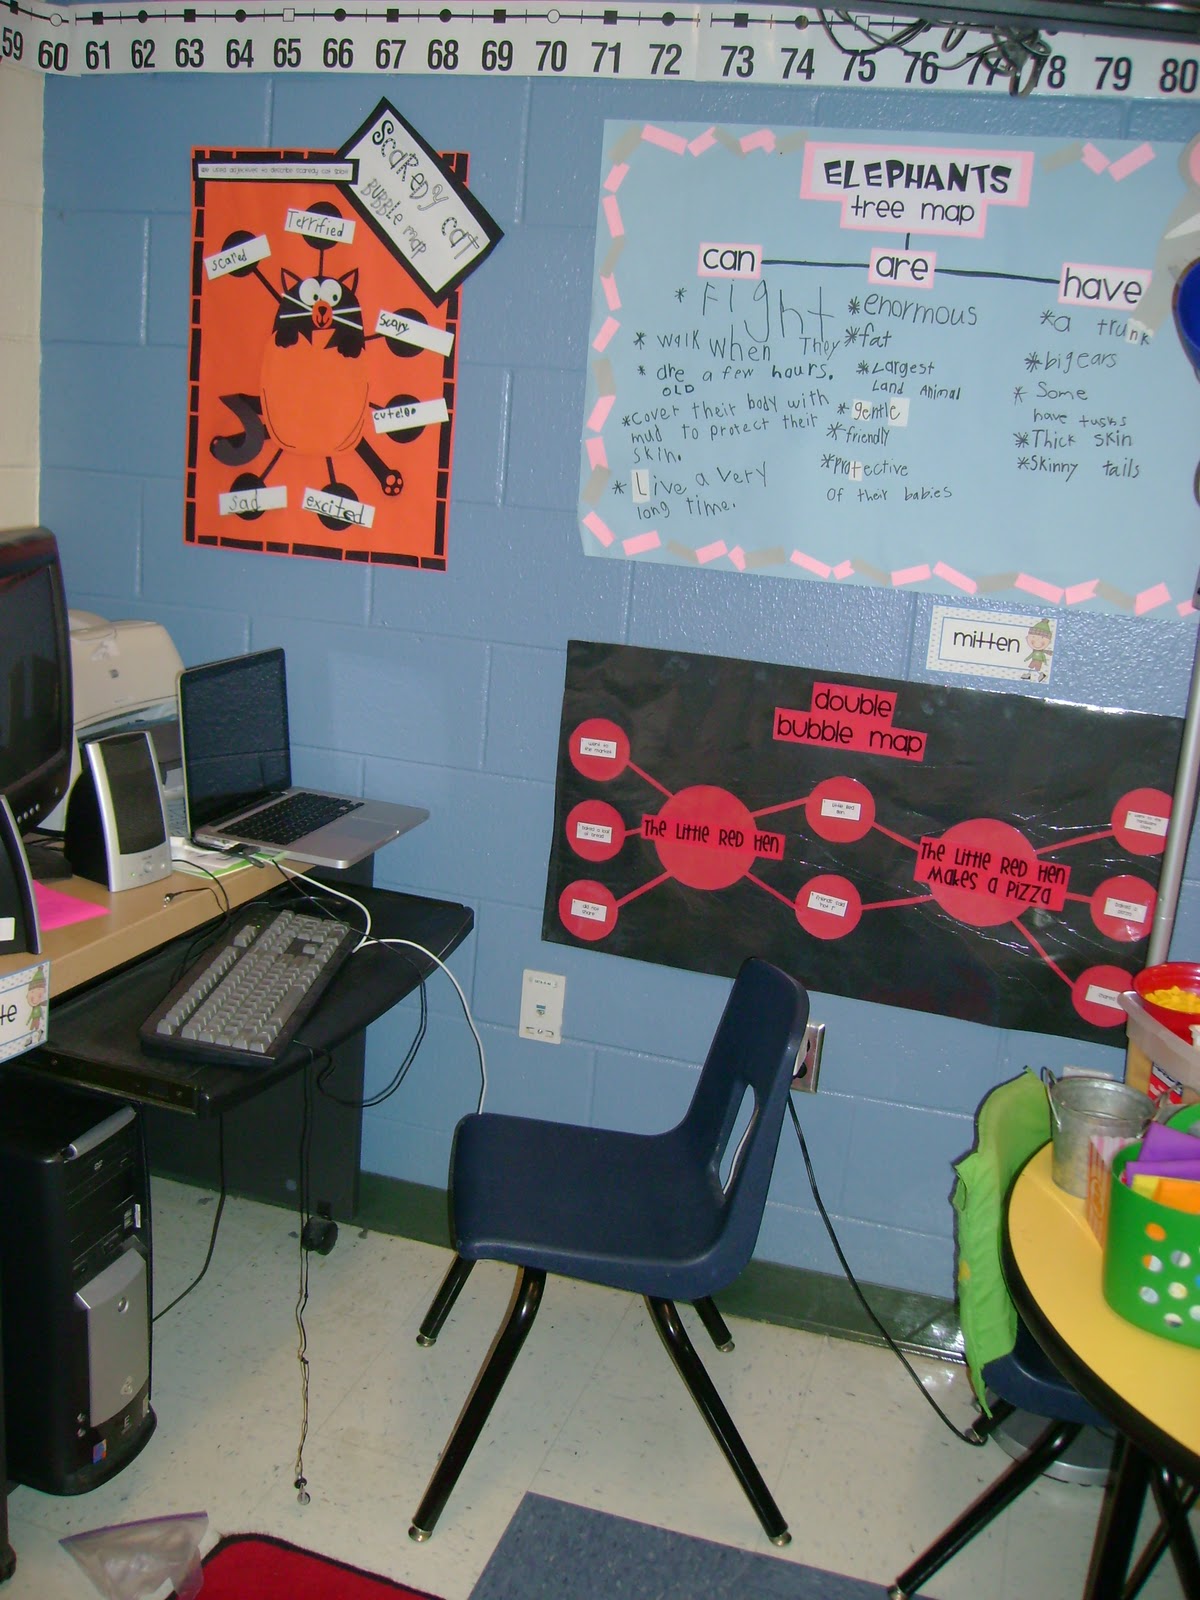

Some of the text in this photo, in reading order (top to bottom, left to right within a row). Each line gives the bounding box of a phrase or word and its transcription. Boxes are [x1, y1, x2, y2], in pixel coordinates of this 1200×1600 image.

[2, 27, 24, 61] 59
[37, 40, 69, 72] 60
[85, 40, 111, 69] 61
[130, 39, 156, 69] 62
[174, 39, 205, 68] 63
[225, 39, 254, 68] 64
[273, 38, 302, 68] 65
[323, 38, 354, 68] 66
[375, 39, 407, 69] 67
[427, 39, 459, 70] 68
[481, 40, 514, 71] 69
[536, 40, 568, 72] 70
[592, 42, 622, 74] 71
[648, 43, 682, 76] 72
[720, 44, 755, 78] 73
[780, 47, 815, 80] 74
[842, 49, 877, 83] 75
[903, 51, 939, 85] 76
[1094, 56, 1132, 91] 79
[1159, 58, 1197, 94] 80
[823, 159, 1013, 195] ELEPHANTS
[287, 209, 346, 237] Terrified
[850, 194, 975, 226] tree map
[702, 246, 755, 272] can
[875, 254, 929, 283] are
[1063, 269, 1143, 304] have
[702, 278, 836, 344] Fight
[863, 293, 978, 326] enormous
[858, 322, 893, 348] fat
[1053, 315, 1072, 332] a
[702, 370, 713, 382] a
[722, 364, 755, 381] few
[771, 363, 834, 382] hours.
[871, 360, 936, 378] Largest
[661, 384, 695, 397] OLD
[872, 379, 905, 396] Land
[692, 401, 737, 420] their
[746, 393, 779, 413] body
[787, 388, 830, 409] with
[1033, 408, 1068, 424] have
[631, 424, 663, 444] mud
[709, 417, 770, 441] protect
[782, 412, 819, 430] their
[845, 425, 891, 447] friendly
[1102, 457, 1141, 479] tails
[634, 471, 688, 497] Live
[695, 471, 708, 487] a
[857, 488, 889, 502] their
[904, 486, 953, 502] babies
[305, 494, 366, 524] excited
[637, 494, 737, 520] long time.
[952, 629, 1021, 654] mitten
[814, 688, 893, 718] double
[776, 713, 924, 757] bubble map
[644, 819, 668, 838] The
[675, 823, 710, 844] Little
[921, 842, 946, 862] The
[954, 847, 992, 871] Little
[987, 877, 999, 894] a
